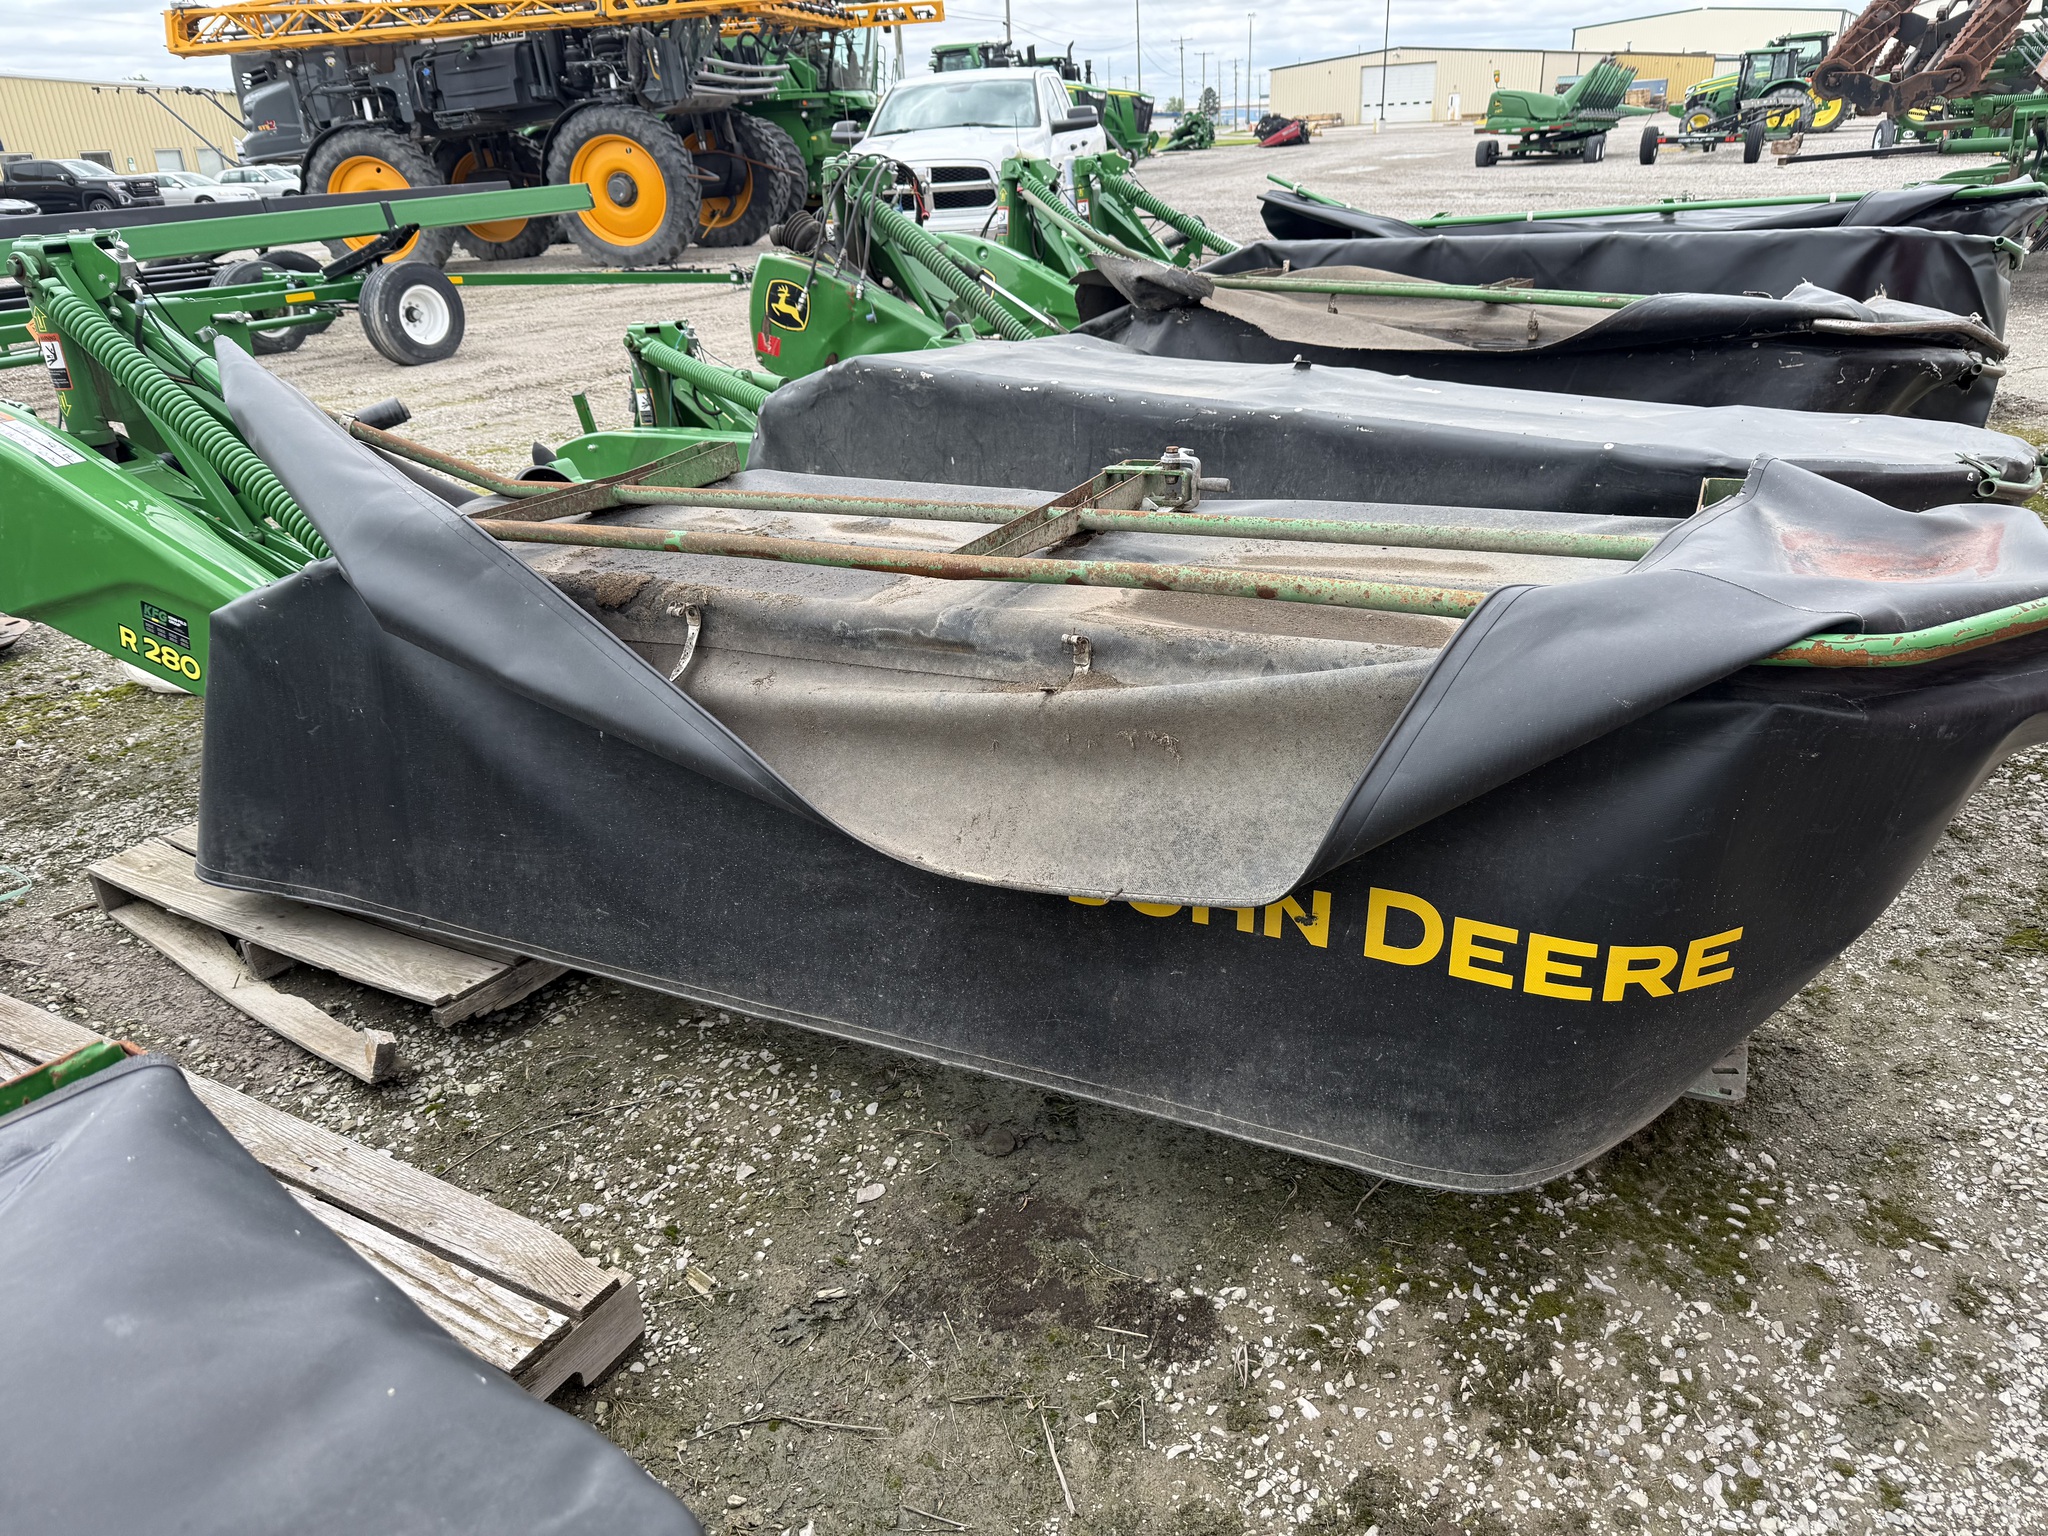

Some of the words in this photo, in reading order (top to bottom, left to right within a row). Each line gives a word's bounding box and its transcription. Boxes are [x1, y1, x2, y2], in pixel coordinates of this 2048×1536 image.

[144, 604, 168, 622] KFG
[119, 624, 139, 654] R
[143, 637, 201, 681] 280
[1364, 886, 1745, 1003] DEERE
